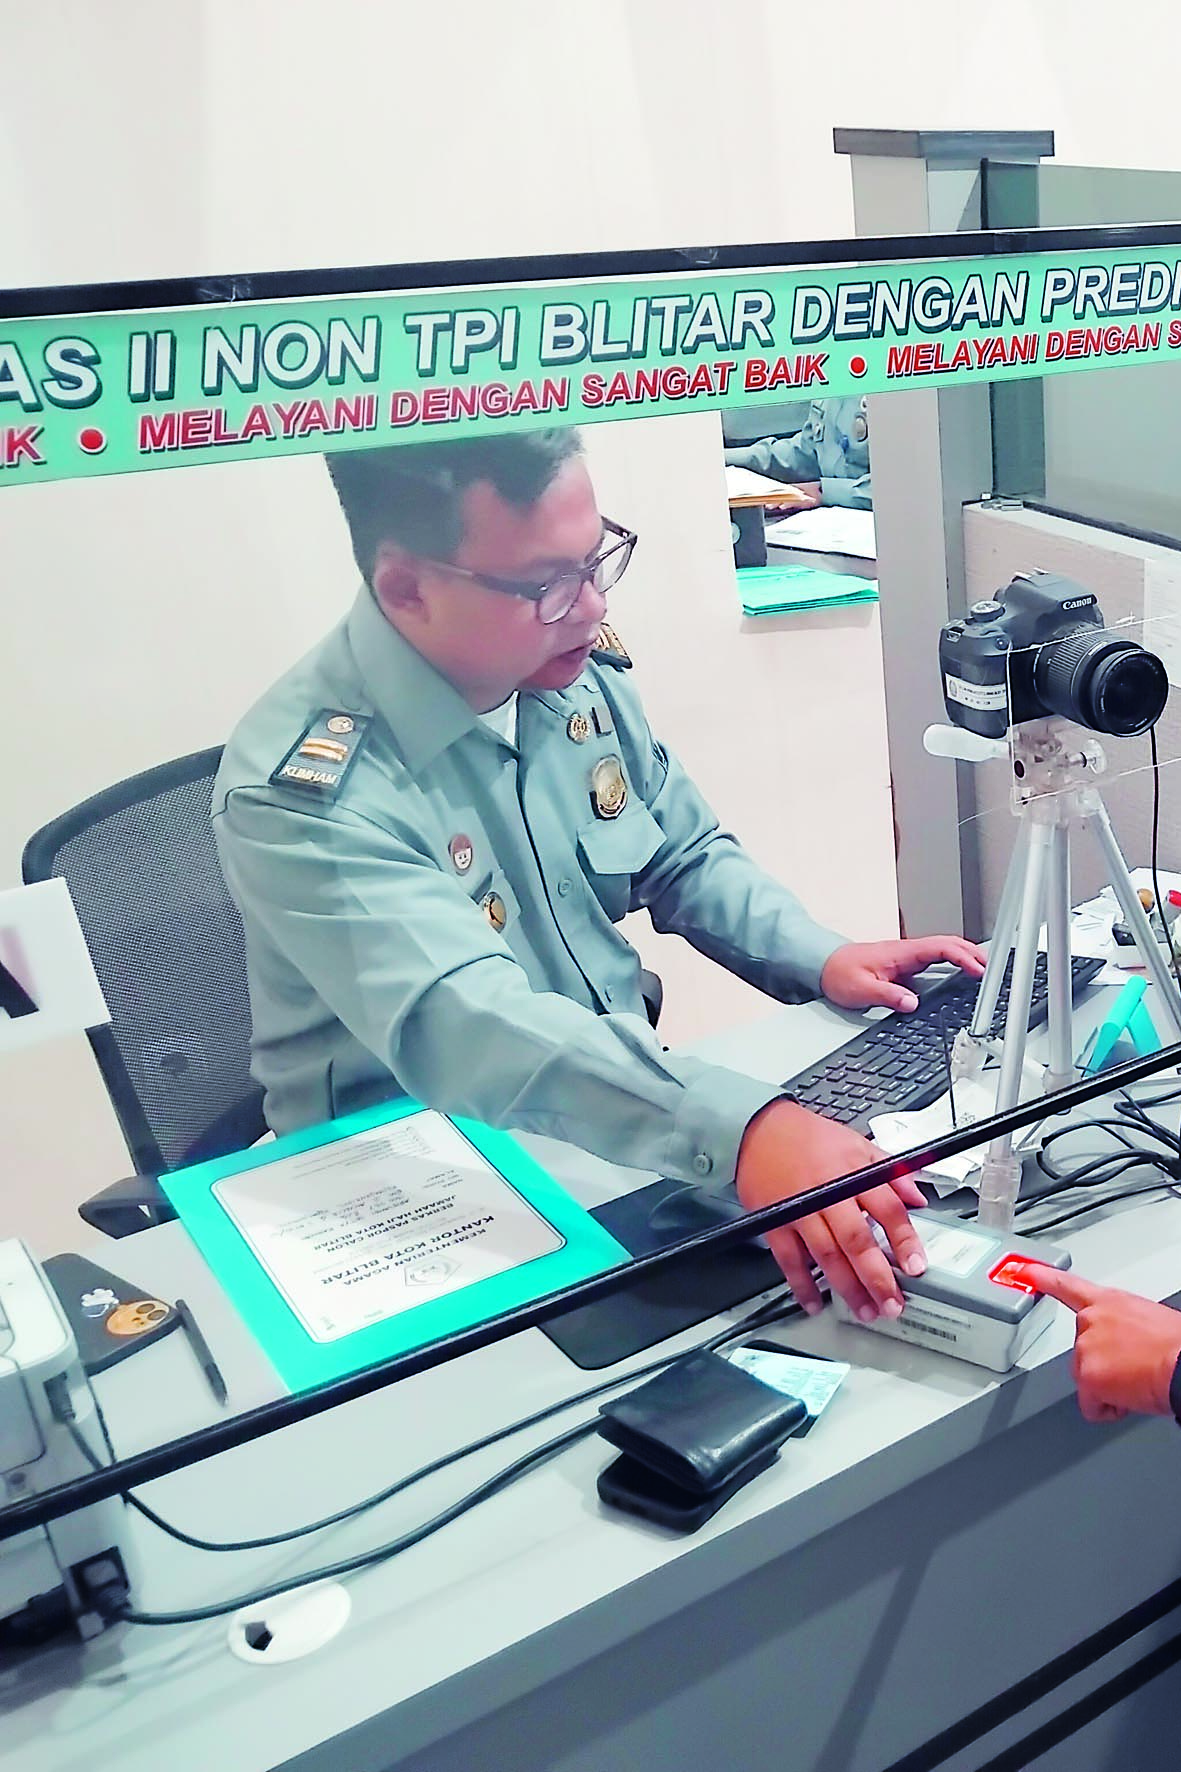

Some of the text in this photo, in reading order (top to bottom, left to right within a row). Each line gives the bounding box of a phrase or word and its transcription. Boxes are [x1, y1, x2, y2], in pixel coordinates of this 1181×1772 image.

[129, 330, 176, 402] II
[201, 315, 382, 396] NON
[403, 306, 521, 376] TPI
[539, 290, 775, 367] BLITAR
[791, 271, 1030, 345] DENGAN
[0, 425, 47, 469] K
[139, 394, 378, 454] MELAYANI
[390, 376, 570, 428] DENGAN
[581, 361, 735, 408] SANGAT
[744, 353, 830, 393] BAIK
[887, 333, 1039, 378] MELAYANI
[1045, 322, 1162, 362] DENGAN
[1062, 596, 1093, 611] Canon
[321, 1215, 495, 1285] KANTOR KOTA BLITAR
[344, 1265, 390, 1286] AGAMA
